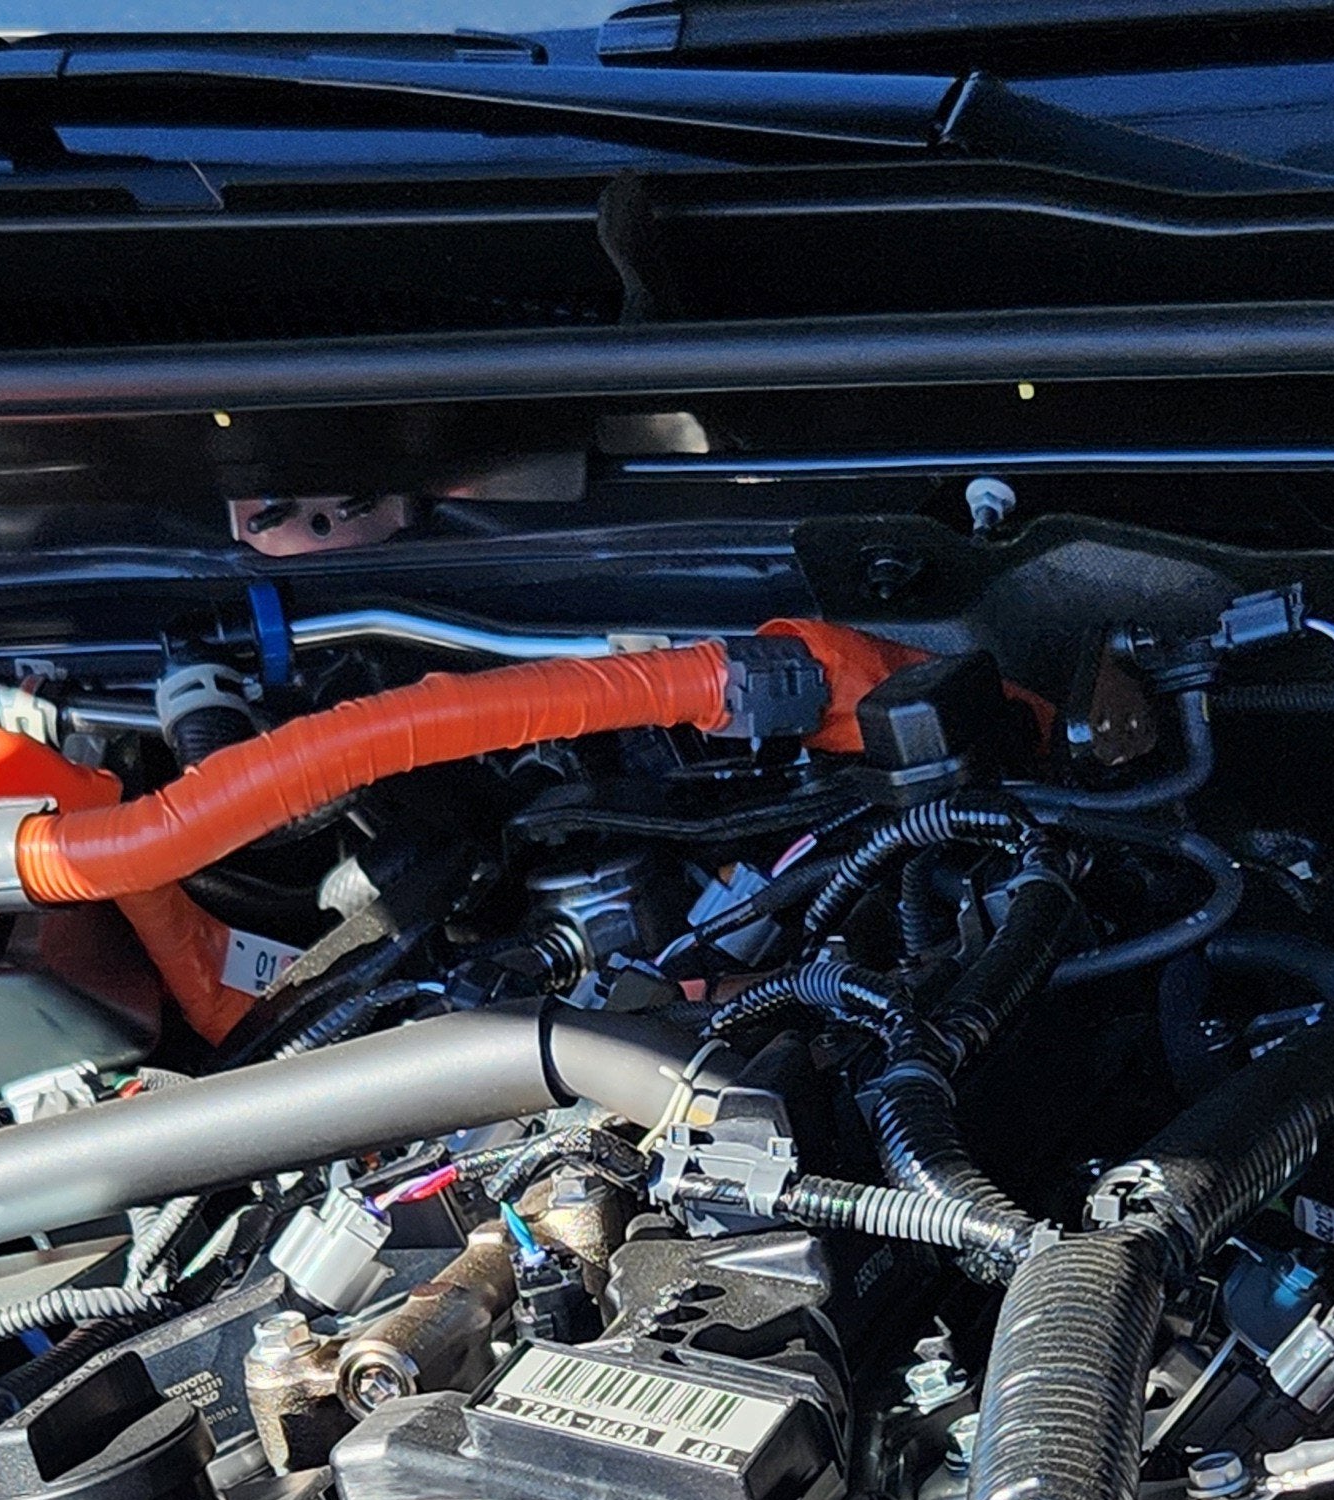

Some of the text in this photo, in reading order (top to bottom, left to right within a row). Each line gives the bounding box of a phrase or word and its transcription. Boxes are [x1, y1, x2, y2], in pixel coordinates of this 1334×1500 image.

[163, 1371, 214, 1398] TOYOTA
[515, 1400, 652, 1446] T24A-N43A
[684, 1442, 734, 1465] 461
